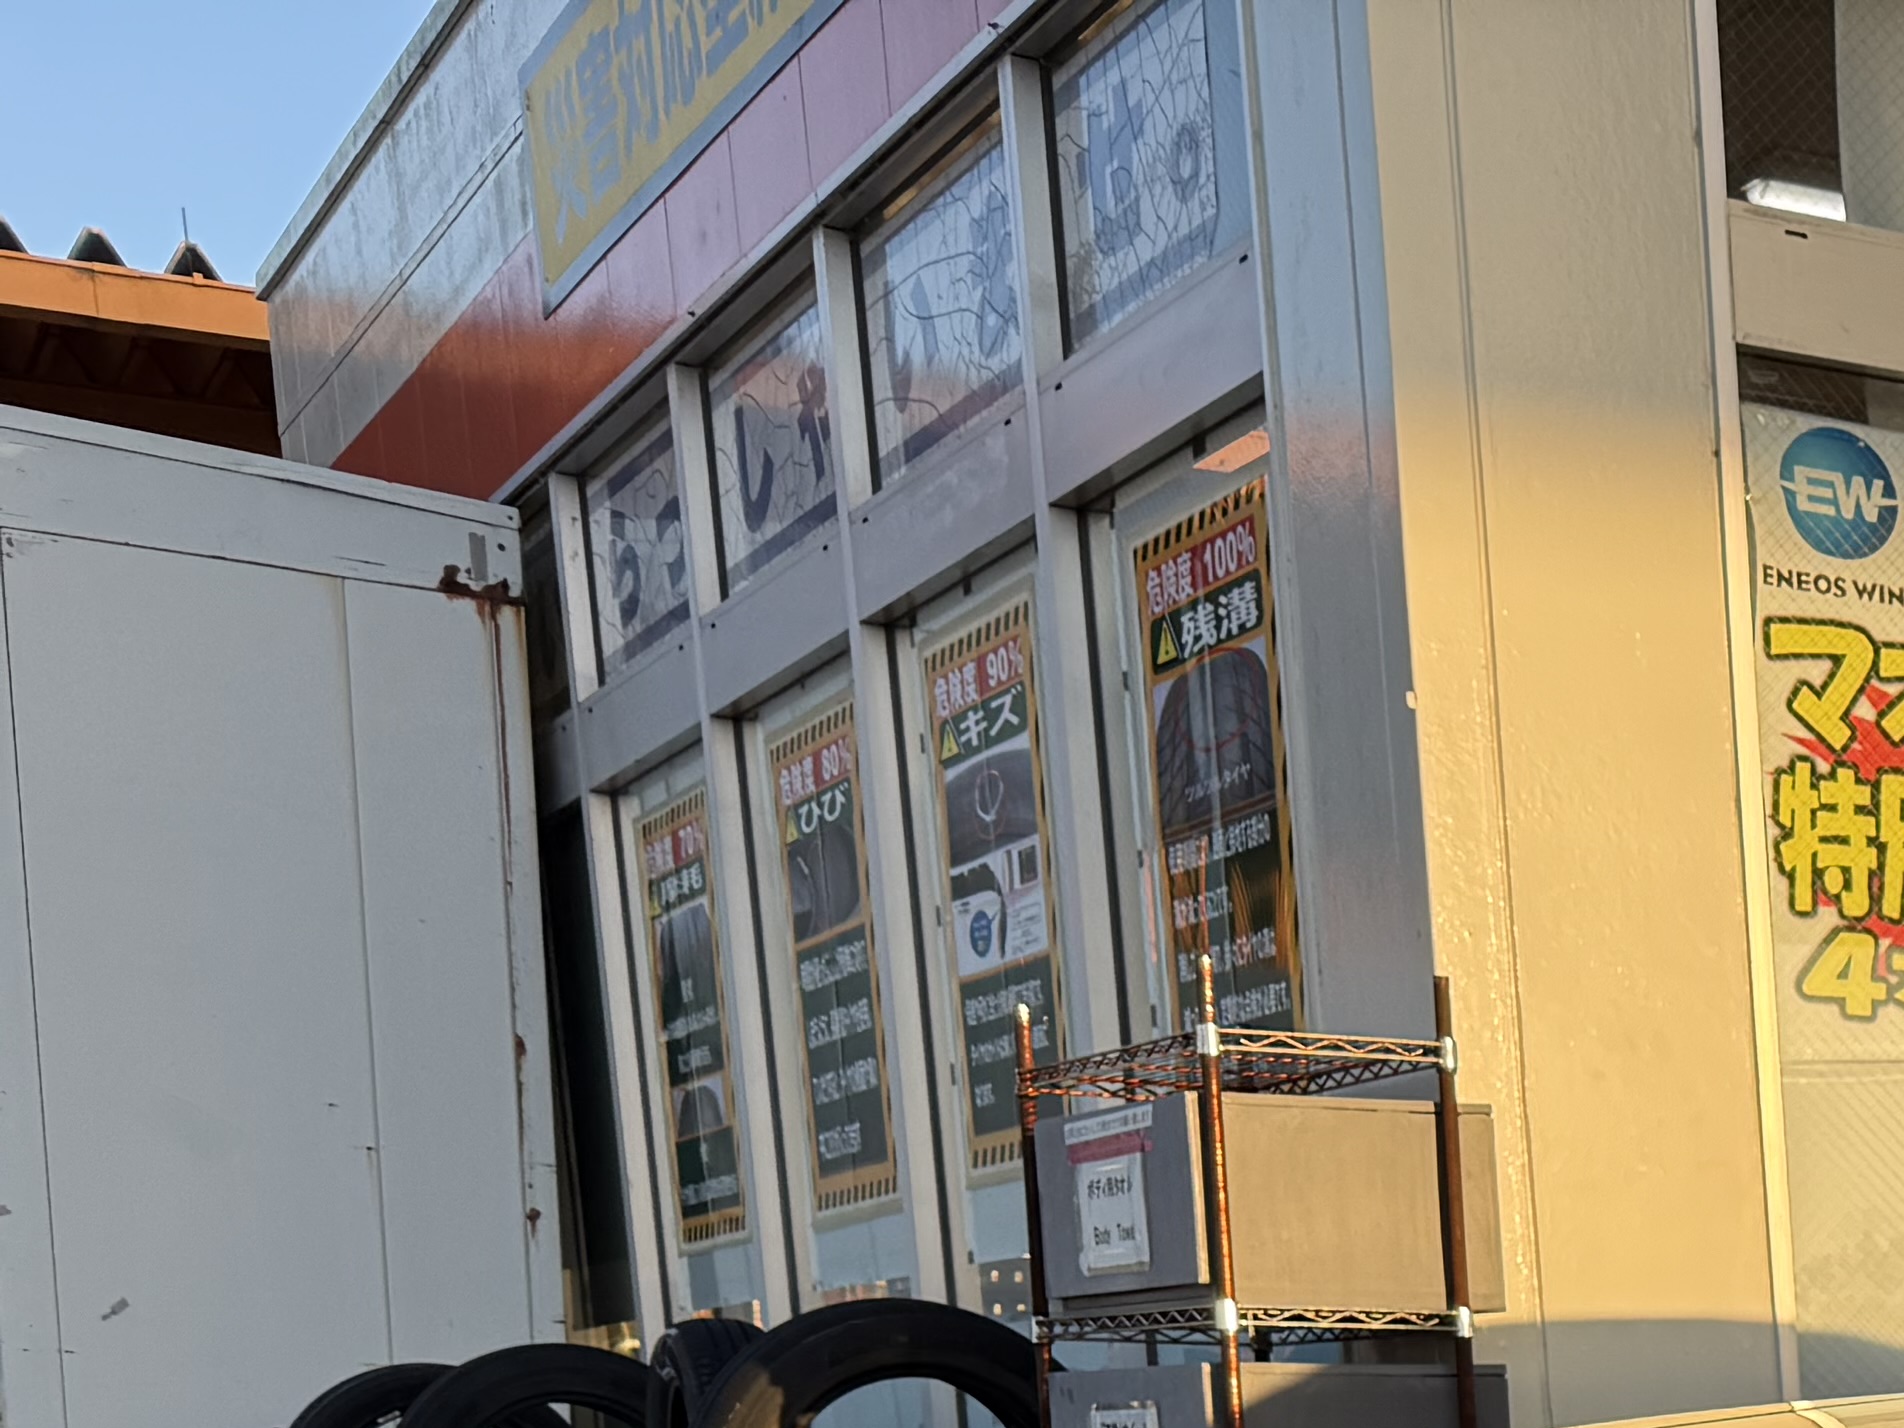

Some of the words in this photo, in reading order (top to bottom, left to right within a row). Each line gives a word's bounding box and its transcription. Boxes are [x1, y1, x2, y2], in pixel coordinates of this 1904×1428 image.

[1146, 551, 1195, 615] 危険度
[1203, 521, 1256, 583] 100%
[1762, 563, 1848, 599] ENEOS
[1180, 580, 1260, 659] 残溝
[934, 660, 980, 719] 危険度
[986, 637, 1025, 688] 90%
[958, 683, 1023, 747] キズ
[821, 736, 851, 782] 80%
[798, 780, 850, 835] ひび
